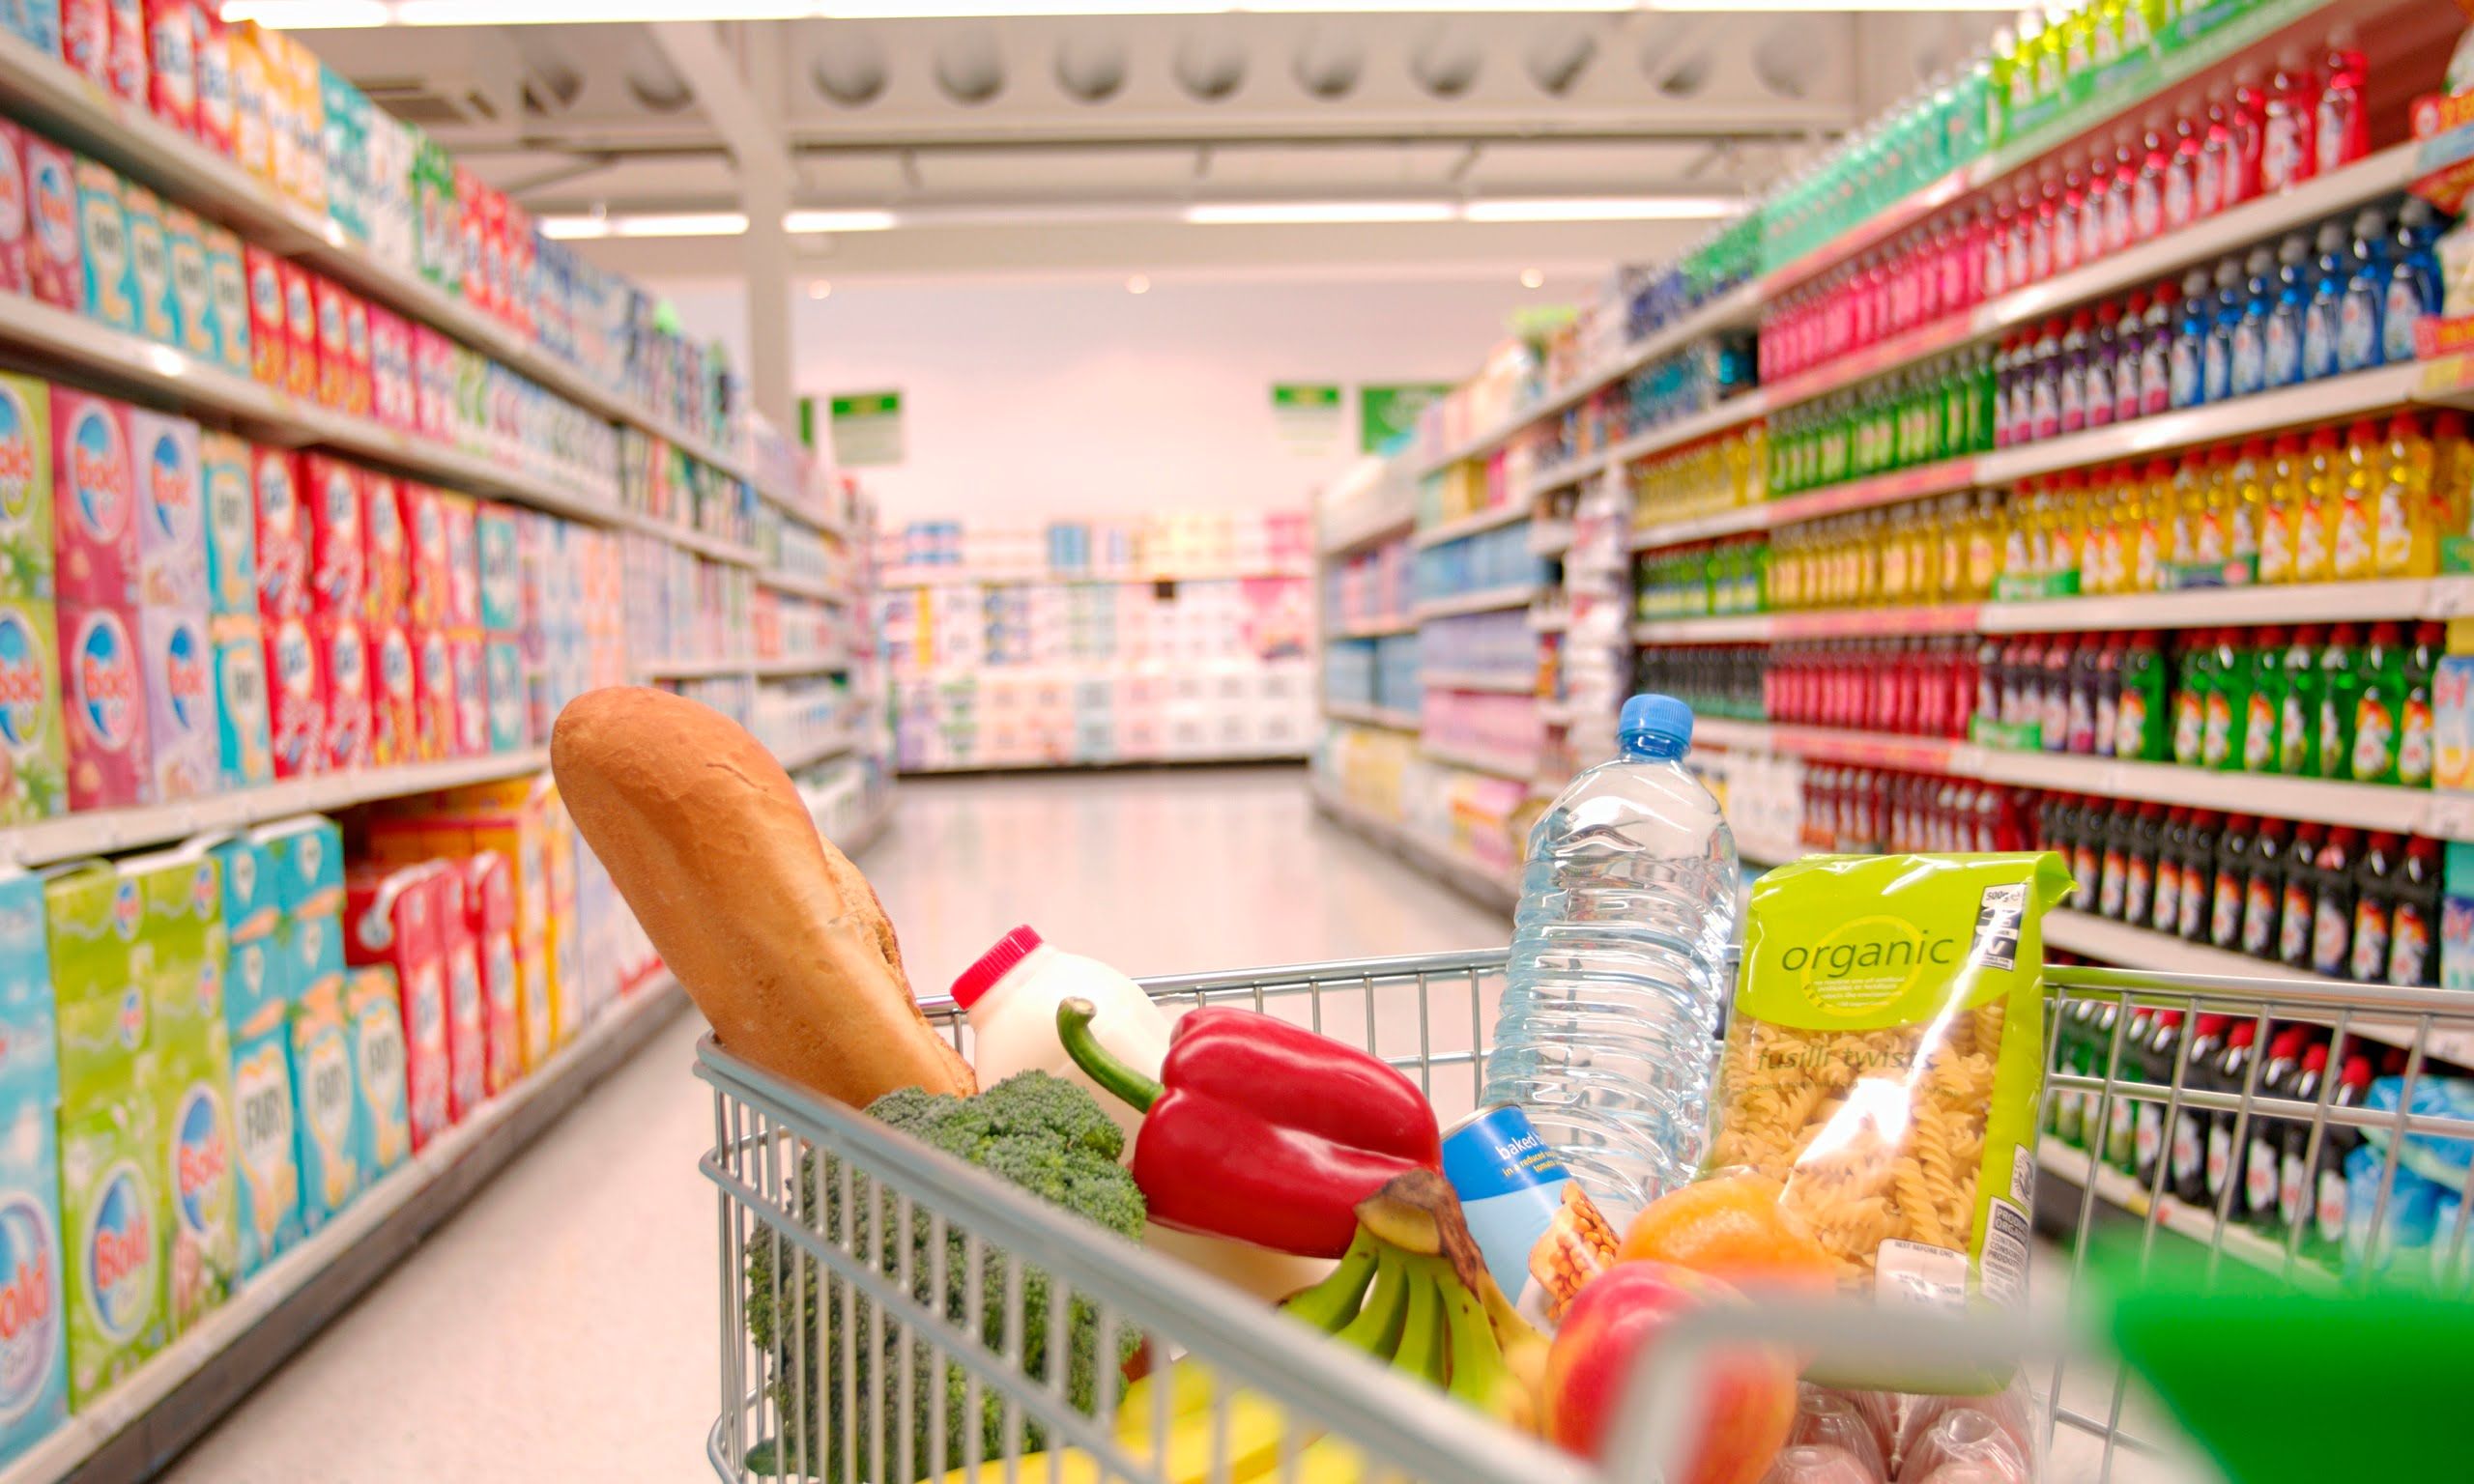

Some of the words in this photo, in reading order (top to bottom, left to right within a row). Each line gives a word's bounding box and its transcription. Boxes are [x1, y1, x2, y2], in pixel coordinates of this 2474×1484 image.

[1782, 929, 1954, 978] organic
[1757, 1045, 1828, 1070] fusilli
[1495, 1131, 1539, 1159] baked
[1502, 1167, 1514, 1177] in
[1520, 1150, 1546, 1168] reduced
[97, 1210, 150, 1291] Bold
[0, 1251, 49, 1341] old
